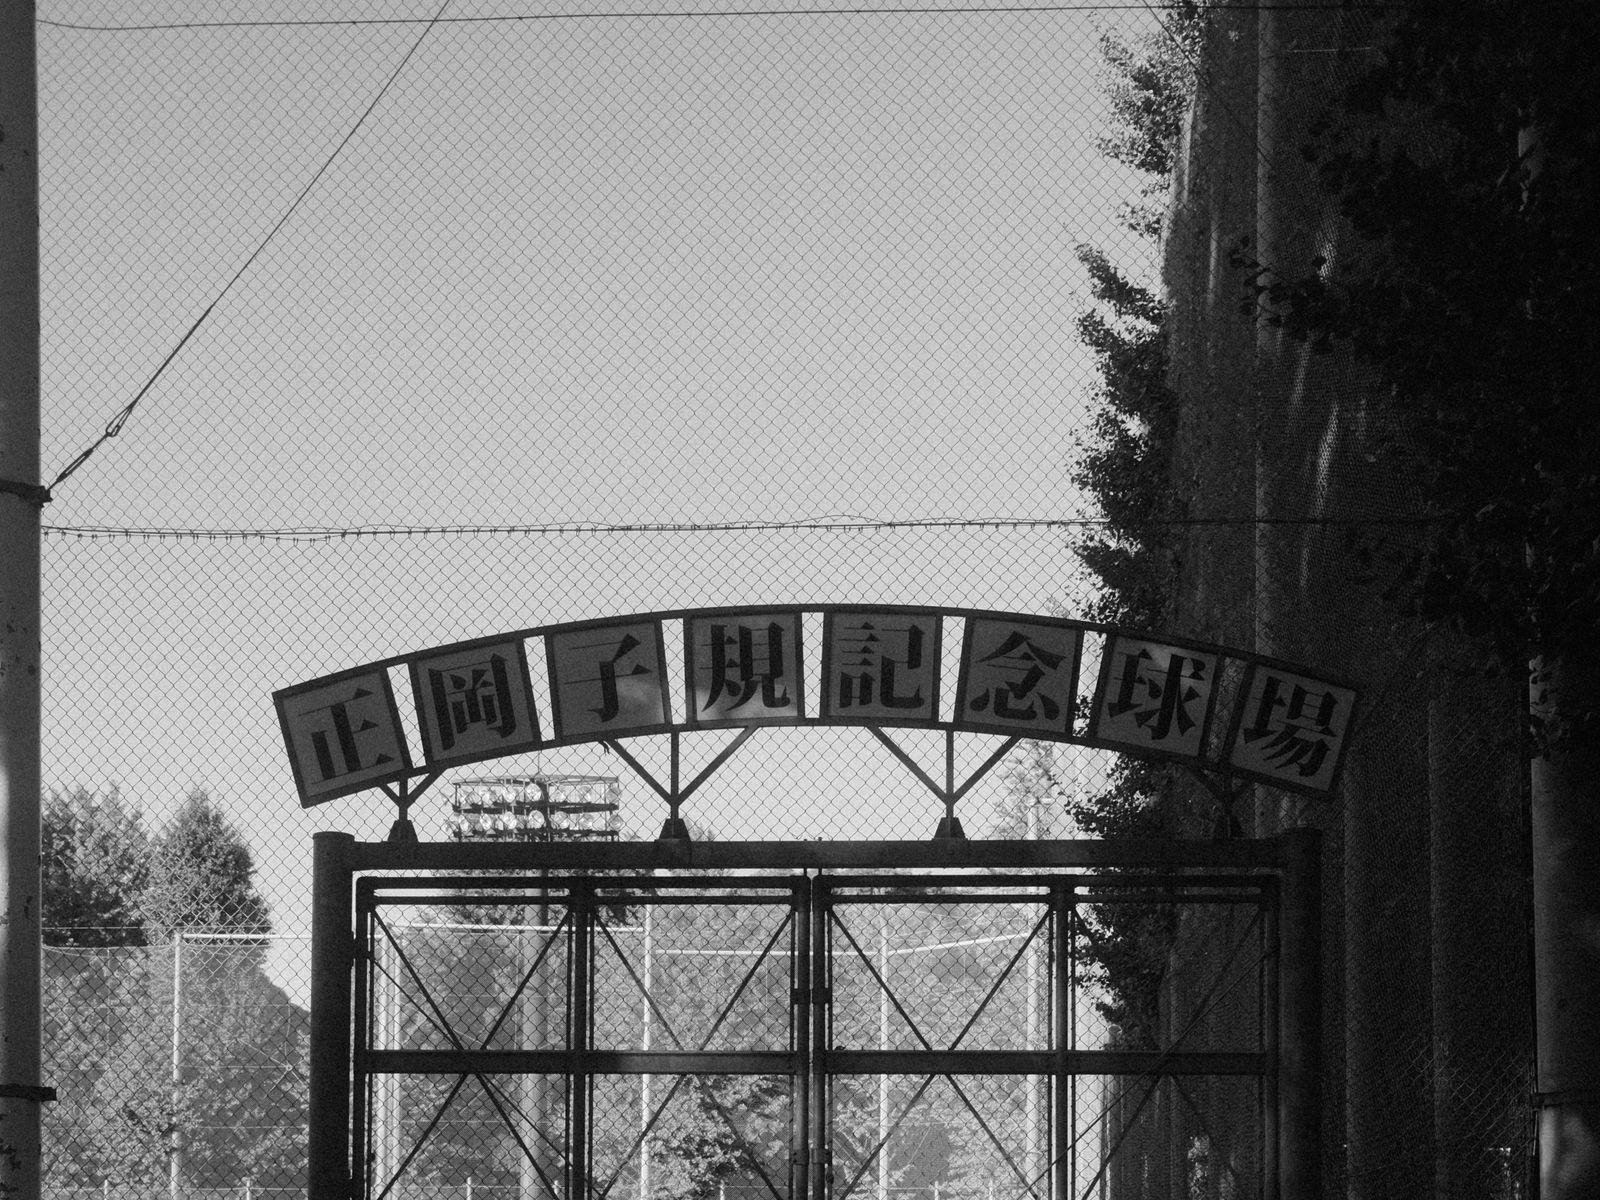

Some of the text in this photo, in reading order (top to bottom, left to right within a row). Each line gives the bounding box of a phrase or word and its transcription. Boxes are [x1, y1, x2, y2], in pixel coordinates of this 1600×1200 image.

[298, 621, 1338, 786] 正岡子規記念球場
